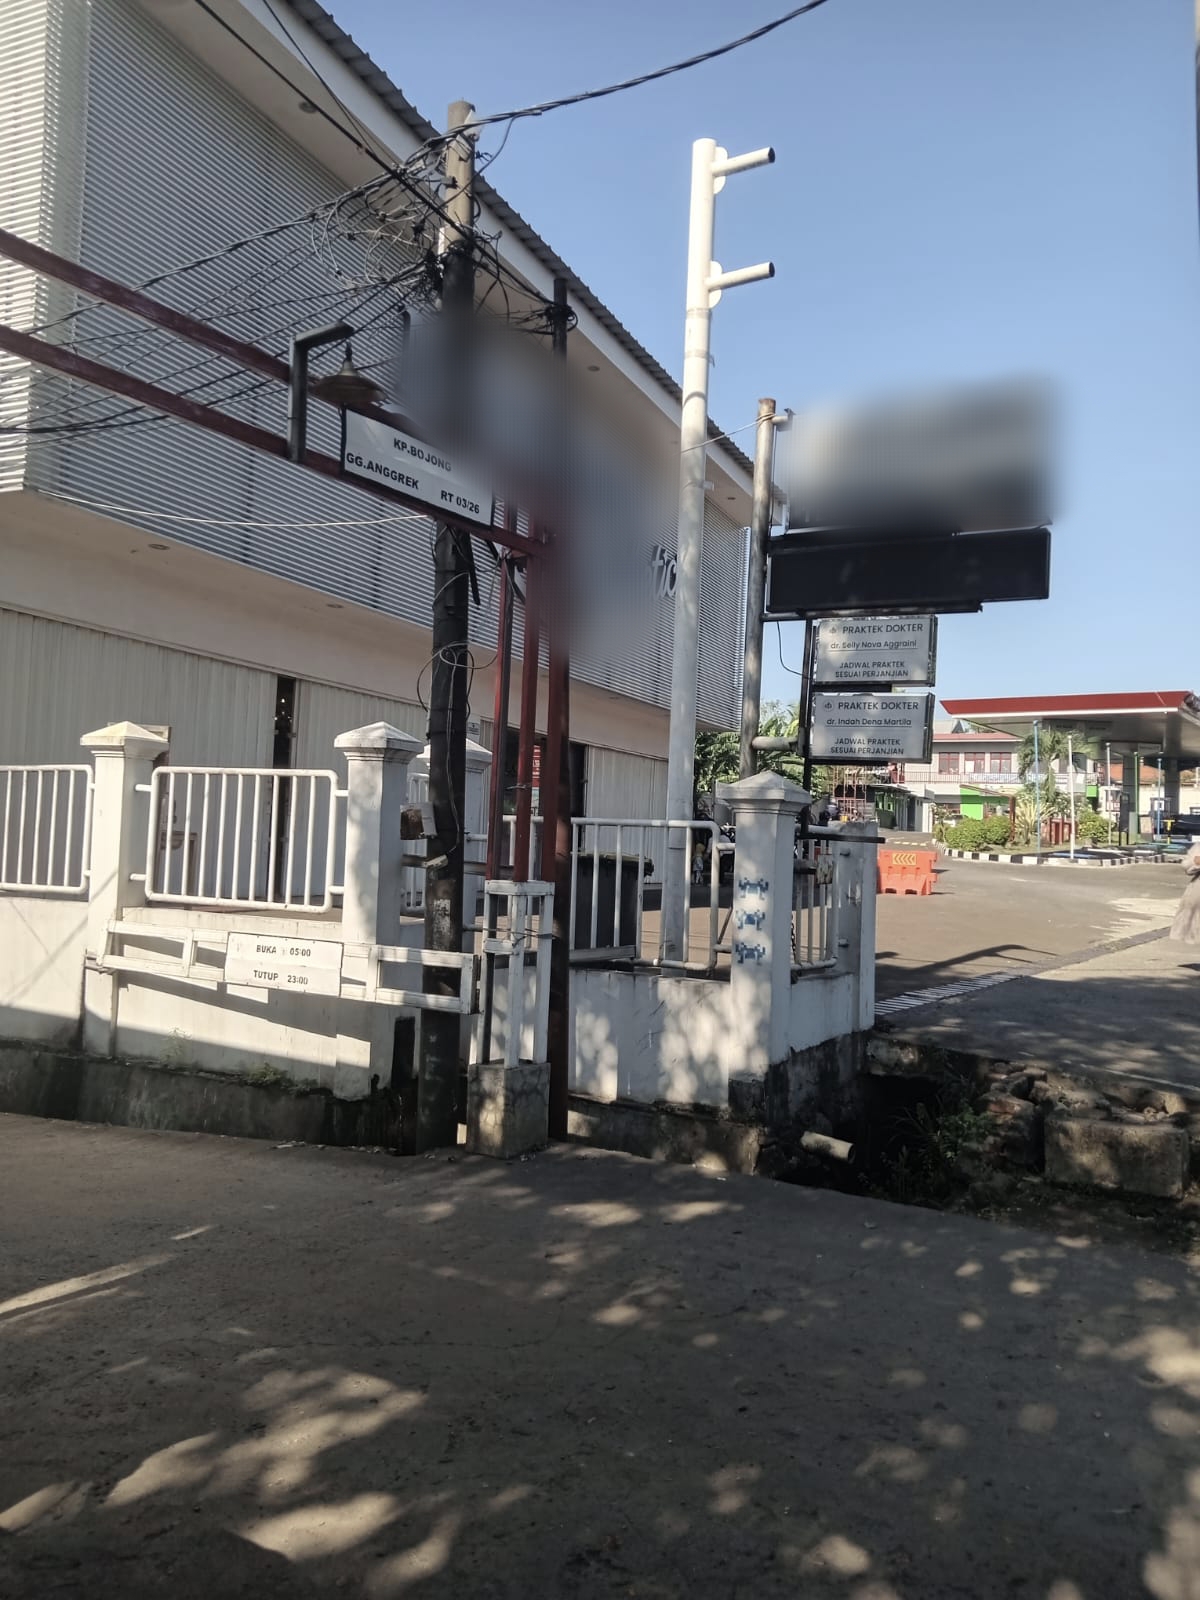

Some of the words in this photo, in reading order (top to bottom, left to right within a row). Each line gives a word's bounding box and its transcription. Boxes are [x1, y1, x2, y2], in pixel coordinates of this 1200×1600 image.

[346, 452, 420, 490] GG.ANGGREK
[440, 489, 454, 503] RT
[456, 496, 480, 514] 03/26
[842, 624, 884, 634] PRAKTEK
[885, 623, 924, 633] DOKTER
[830, 641, 840, 649] dr.
[861, 640, 882, 649] Nova
[883, 639, 917, 650] Aggraini
[840, 661, 871, 669] JADWAL
[871, 660, 905, 669] PRAKTEK
[862, 669, 909, 678] PERJANJIAN
[838, 701, 879, 710] PRAKTEK
[880, 701, 919, 710] DOKTER
[826, 718, 837, 726] dr.
[838, 718, 860, 726] Indah
[834, 737, 866, 745] JADWAL
[867, 738, 901, 746] PRAKTEK
[857, 747, 904, 755] PERJANJIAN
[256, 944, 277, 954] BUKA
[289, 947, 311, 957] 05:00
[253, 969, 279, 981] TUTUP
[287, 974, 309, 985] 23:00
